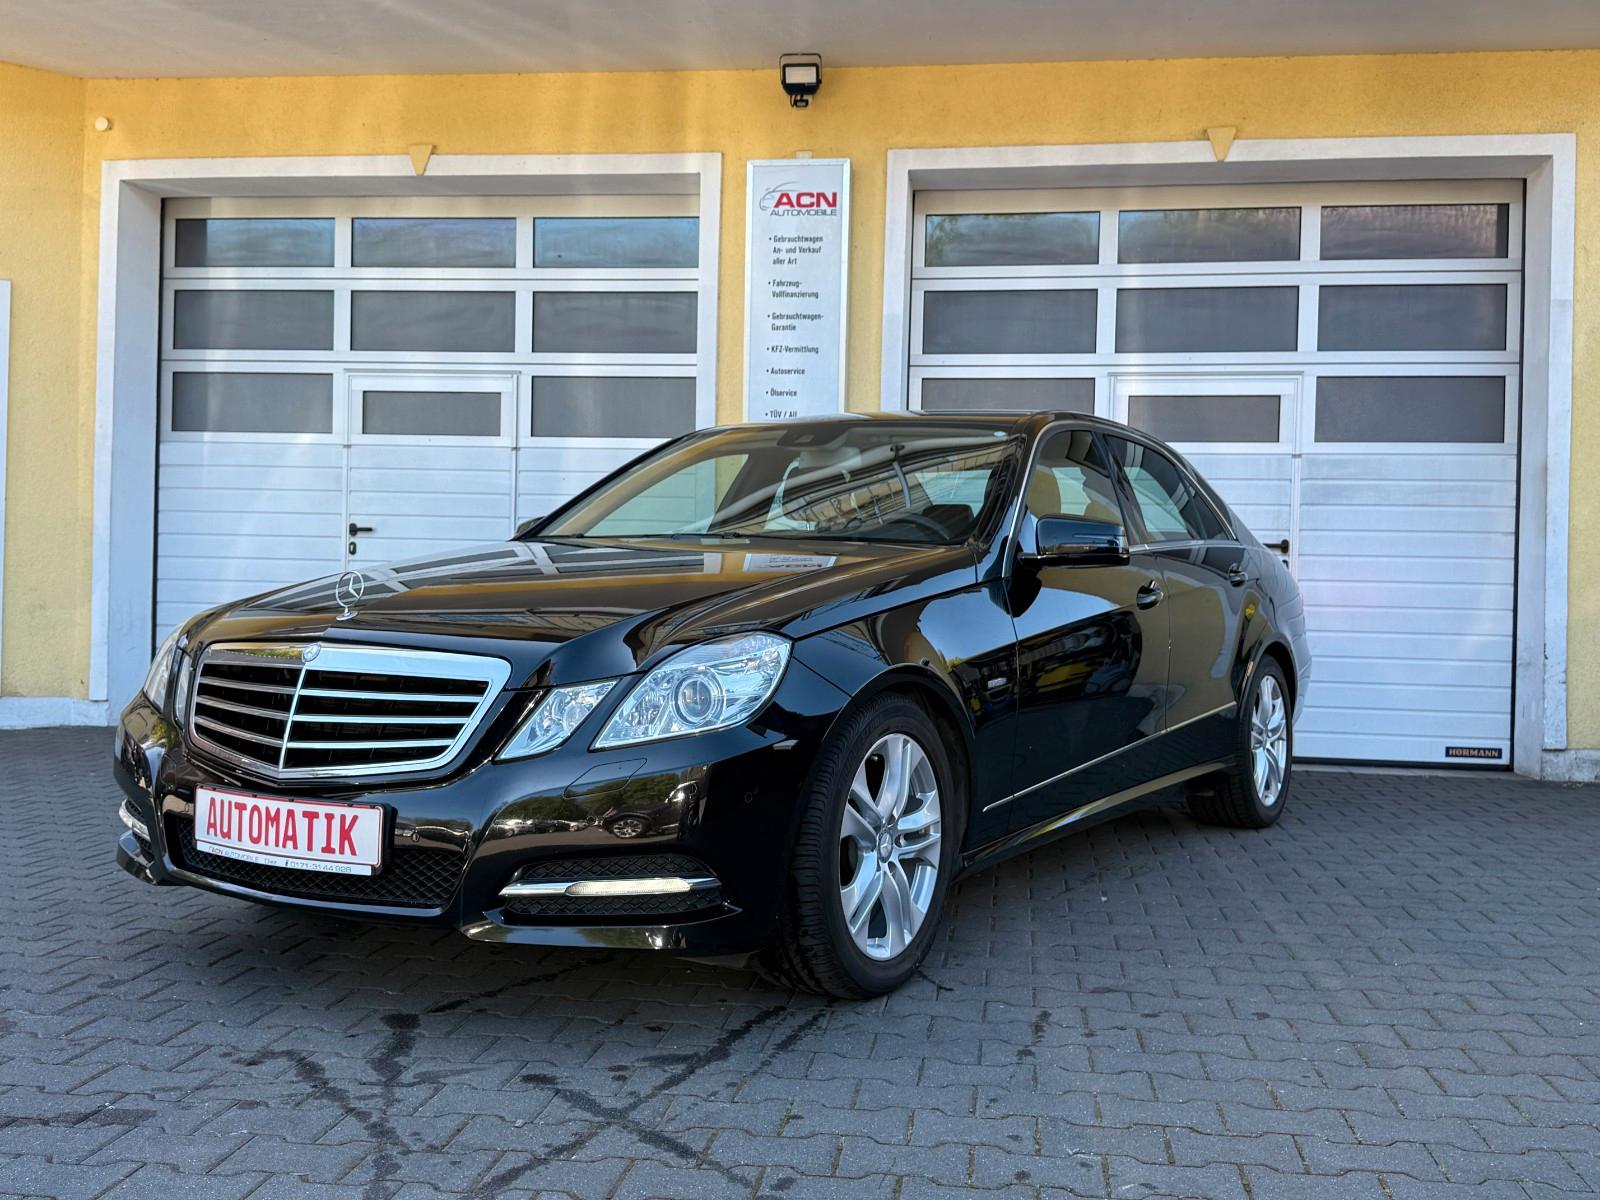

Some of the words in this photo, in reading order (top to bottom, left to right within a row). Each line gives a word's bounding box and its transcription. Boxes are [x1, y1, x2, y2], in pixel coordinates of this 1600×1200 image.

[773, 191, 837, 208] ACN
[770, 208, 837, 216] AUTOMOBILE
[773, 235, 823, 244] Gebrauchtwagen
[772, 246, 783, 254] An-
[785, 246, 797, 254] und
[798, 246, 822, 254] Verkauf
[772, 257, 785, 265] aller
[787, 257, 797, 265] Art
[772, 279, 802, 288] Fahrzeug-
[771, 290, 819, 299] Vollfinanzierung
[771, 312, 824, 321] Gebrauchtwagen-
[771, 323, 796, 331] Garantie
[770, 345, 819, 354] KFZ-Vermittlung
[770, 387, 797, 396] Ölservice
[770, 409, 781, 418] TÜV
[206, 797, 359, 856] AUTOMATIK
